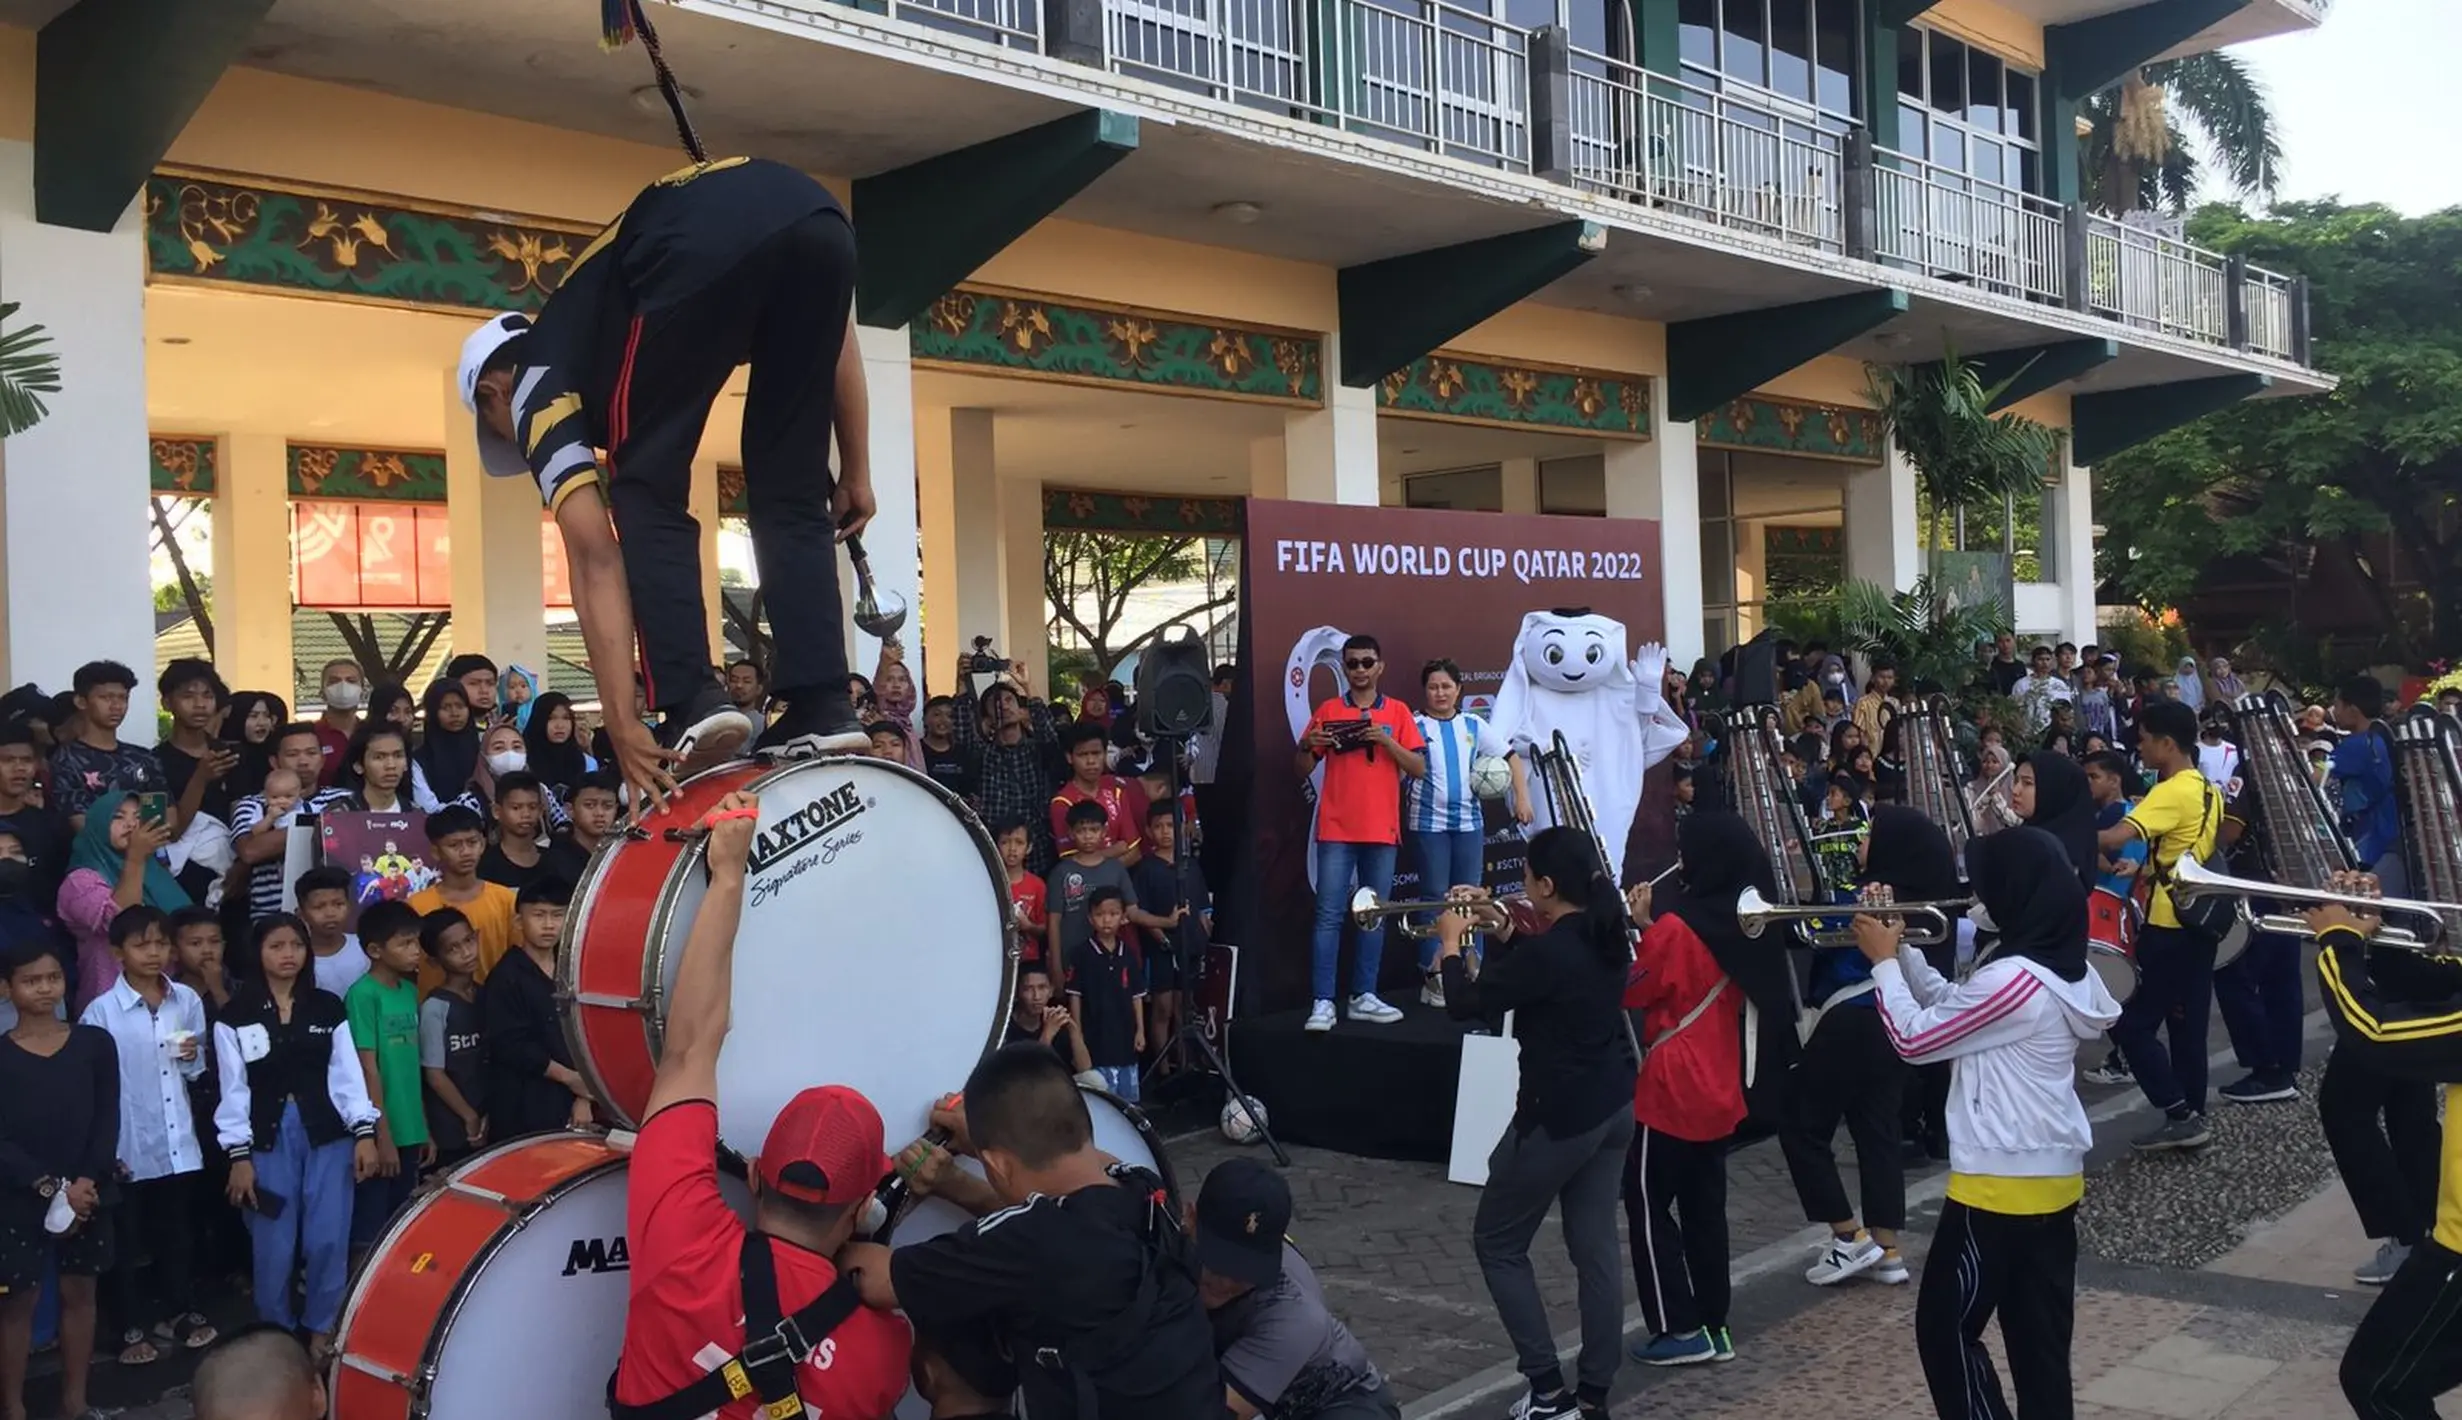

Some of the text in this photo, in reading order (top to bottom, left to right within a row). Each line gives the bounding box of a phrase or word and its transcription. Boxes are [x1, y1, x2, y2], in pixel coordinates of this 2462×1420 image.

[1276, 540, 1642, 584] FIFA WORLD CUP QATAR 2022
[750, 830, 865, 908] Signature Series
